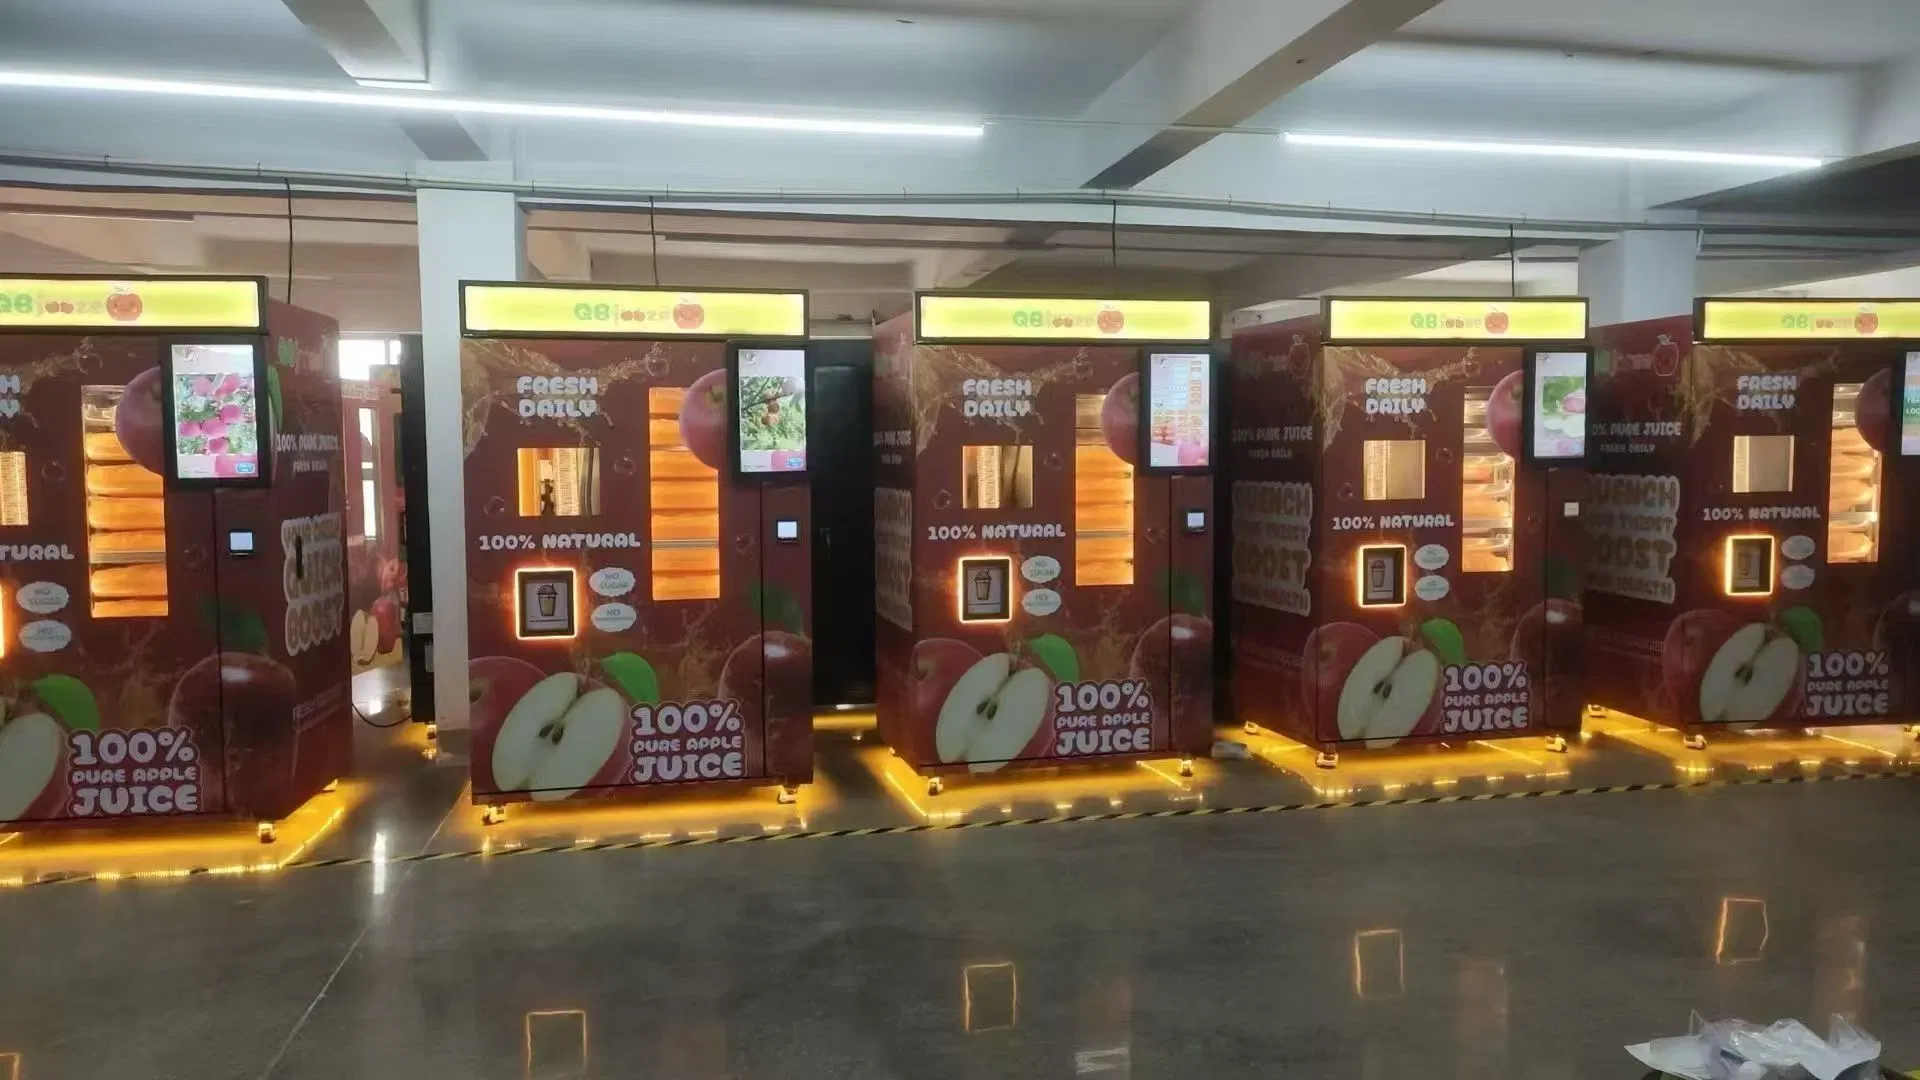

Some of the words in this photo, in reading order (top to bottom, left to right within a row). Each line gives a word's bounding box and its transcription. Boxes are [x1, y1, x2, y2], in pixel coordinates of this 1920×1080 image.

[517, 375, 597, 395] FRESH
[963, 379, 1031, 397] FRESH
[1365, 378, 1426, 395] FRESH
[1738, 376, 1796, 391] FRESH
[519, 399, 597, 417] DAILY
[964, 400, 1031, 417] DAILY
[1366, 398, 1426, 415] DAILY
[1738, 395, 1795, 410] DAILY
[1283, 425, 1313, 442] JUICE
[1643, 421, 1681, 437] JUICE
[1703, 508, 1744, 521] 100%
[1749, 504, 1820, 519] NATURAL
[1332, 515, 1375, 531] 100%
[1380, 513, 1454, 530] NATURAL
[928, 525, 976, 541] 100%
[982, 523, 1066, 540] NATURAL
[479, 534, 535, 551] 100%
[542, 532, 640, 549] NATURAL
[0, 544, 75, 561] TURAL
[605, 572, 619, 580] NO
[606, 608, 621, 616] NO
[1809, 651, 1888, 677] 100%
[1445, 663, 1528, 692] 100%
[1807, 680, 1842, 691] PURE
[1846, 678, 1888, 690] APPLE
[1057, 682, 1149, 712] 100%
[1445, 694, 1481, 706] PURE
[1485, 692, 1528, 705] APPLE
[1807, 693, 1888, 716] JUICE
[632, 703, 741, 736] 100%
[1057, 714, 1097, 728] PURE
[1101, 712, 1150, 726] APPLE
[1445, 706, 1528, 733] JUICE
[72, 733, 195, 766] 100%
[633, 739, 681, 753] PURE
[686, 736, 742, 751] APPLE
[1057, 727, 1150, 755] JUICE
[73, 769, 126, 785] PURE
[133, 766, 197, 783] APPLE
[633, 752, 742, 782] JUICE
[73, 784, 198, 815] JUICE
